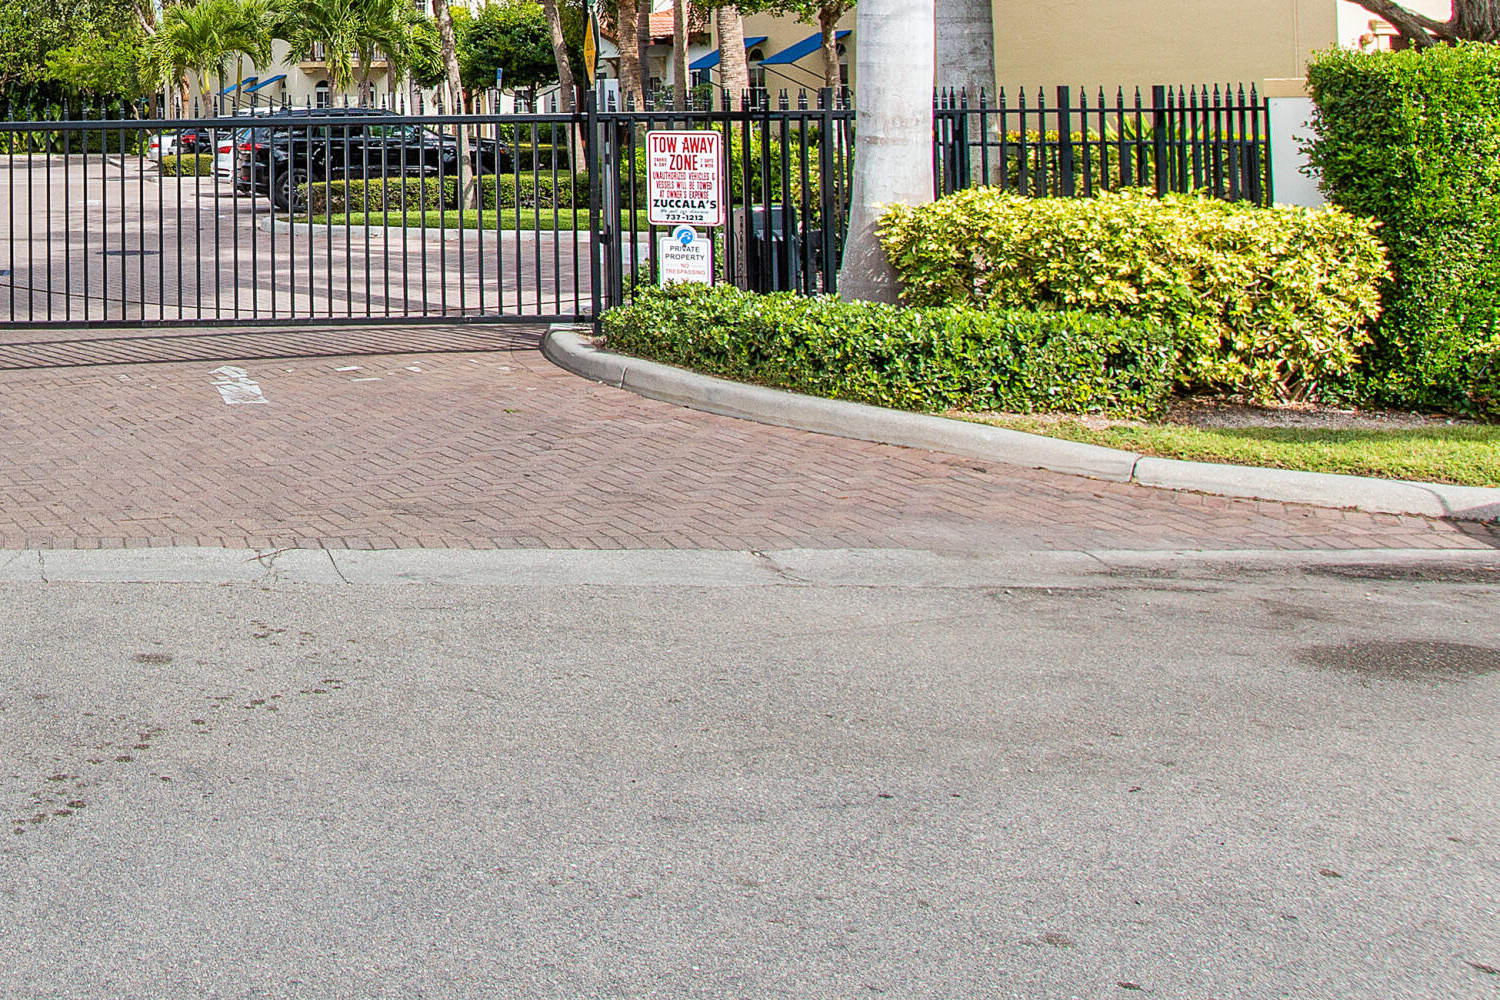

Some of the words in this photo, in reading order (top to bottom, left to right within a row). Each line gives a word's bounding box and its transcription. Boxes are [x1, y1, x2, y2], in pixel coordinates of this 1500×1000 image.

[652, 137, 677, 153] TOW
[682, 137, 715, 153] AWAY
[669, 154, 698, 170] ZONE
[652, 171, 686, 180] UNAUTHORIZED
[688, 172, 709, 180] VEHICLES
[656, 180, 675, 189] VESSELS
[676, 181, 687, 190] WILL
[689, 181, 695, 190] BE
[697, 181, 712, 190] TOWED
[659, 190, 665, 198] AT
[688, 191, 709, 199] EXPENSE
[653, 199, 717, 209] ZUCCALA'S
[669, 245, 701, 253] PRIVATE
[665, 253, 706, 261] PROPERTY
